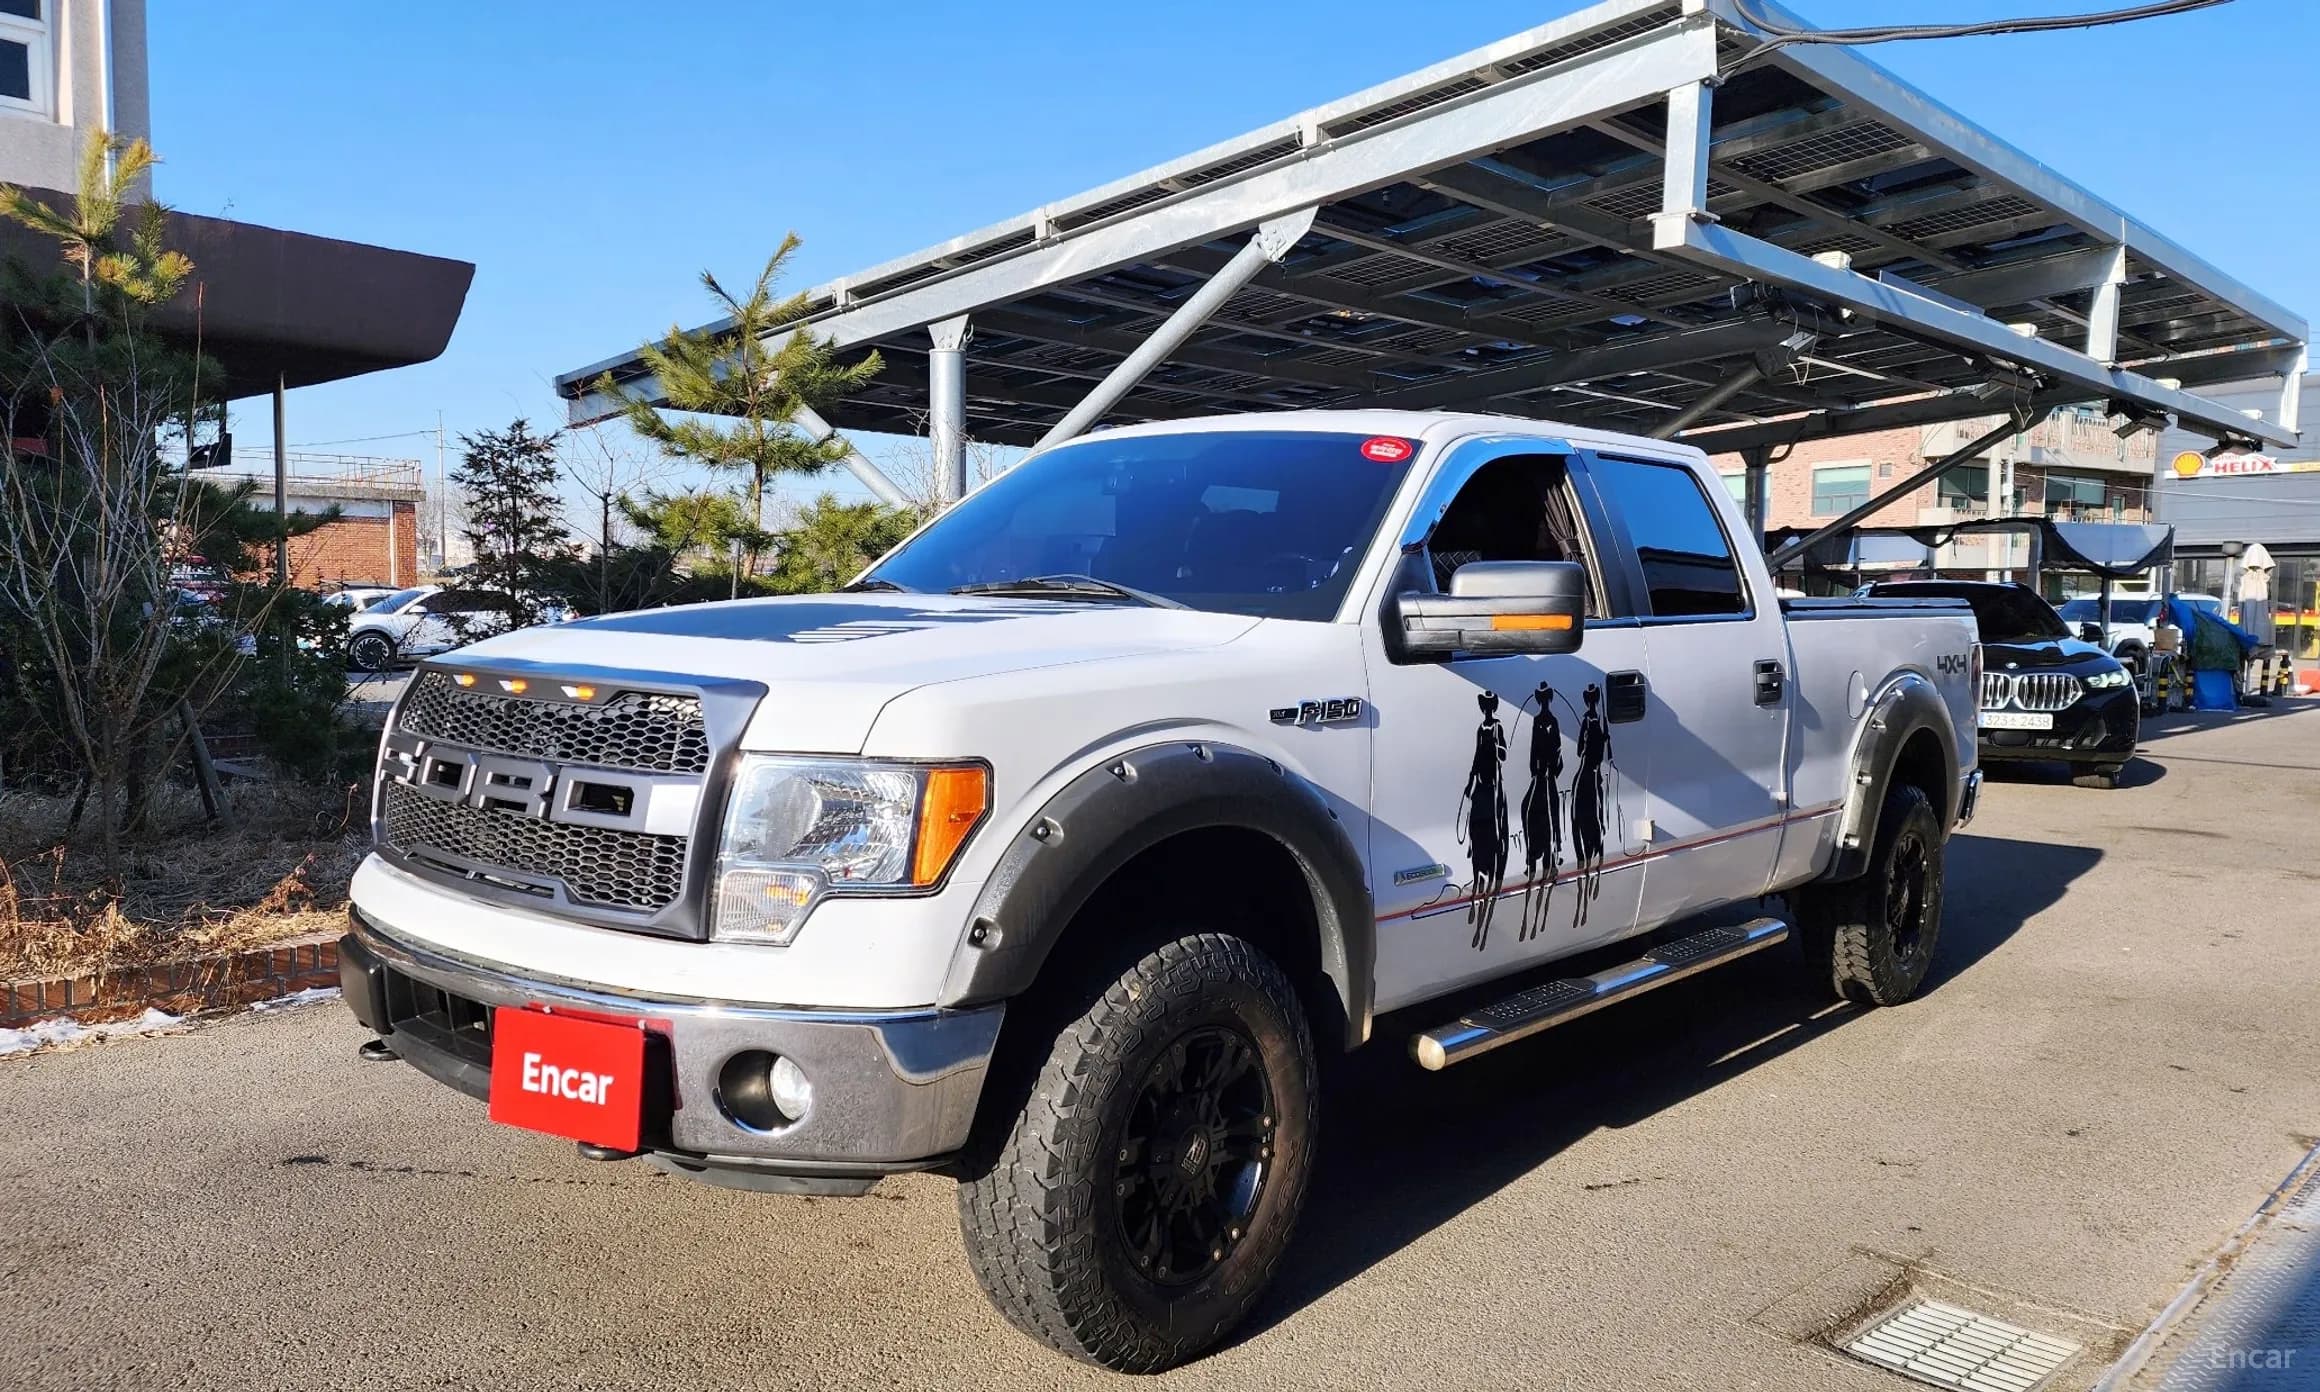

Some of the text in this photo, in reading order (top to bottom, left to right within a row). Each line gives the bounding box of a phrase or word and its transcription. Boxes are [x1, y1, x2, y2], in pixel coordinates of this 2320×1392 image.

[2214, 457, 2273, 473] HELIX
[1936, 654, 1967, 673] 4X4
[522, 1052, 614, 1105] Encar
